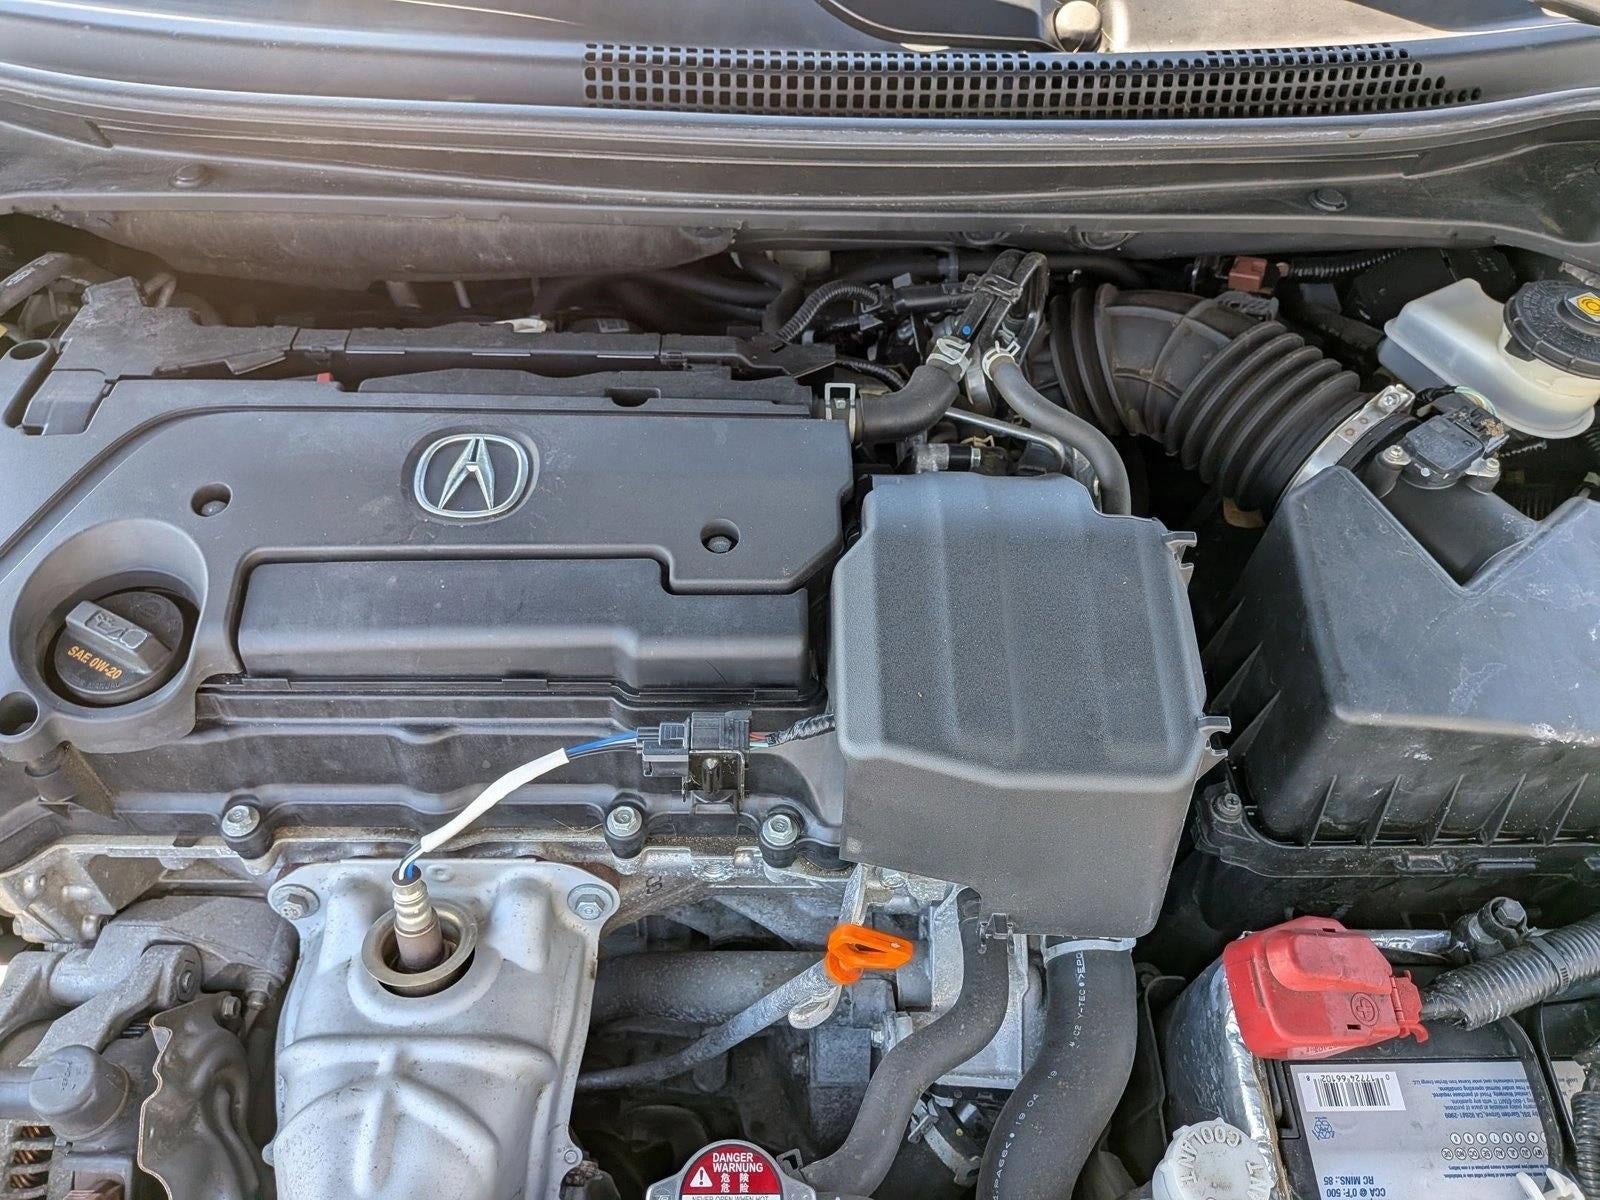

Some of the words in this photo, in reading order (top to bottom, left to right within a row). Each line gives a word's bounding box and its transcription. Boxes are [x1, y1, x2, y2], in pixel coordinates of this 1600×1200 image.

[68, 646, 93, 663] SAE
[90, 658, 122, 679] 0W-20
[713, 1153, 753, 1162] DANGER
[713, 1163, 763, 1173] WARNUNG
[1324, 1177, 1333, 1185] 85
[1363, 1176, 1373, 1184] RC
[1327, 1189, 1340, 1197] 500
[1369, 1188, 1386, 1196] CCA
